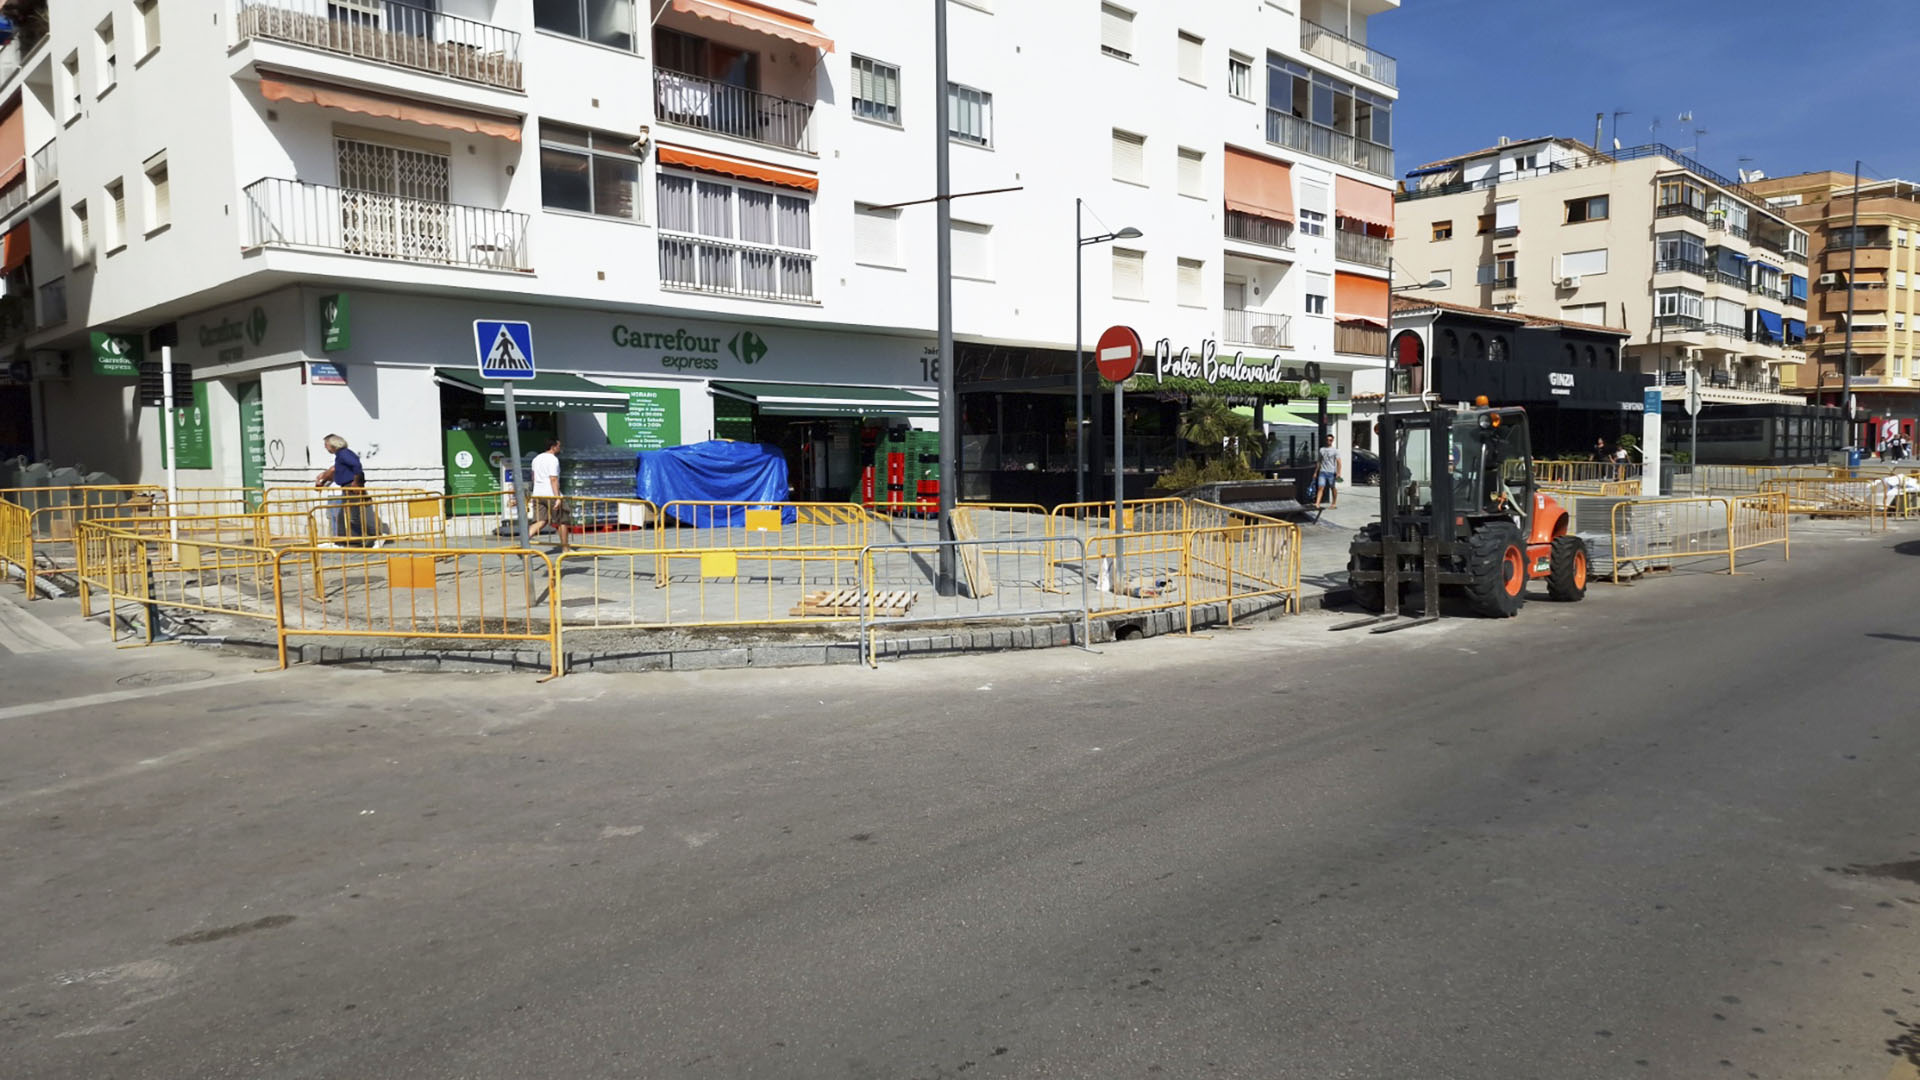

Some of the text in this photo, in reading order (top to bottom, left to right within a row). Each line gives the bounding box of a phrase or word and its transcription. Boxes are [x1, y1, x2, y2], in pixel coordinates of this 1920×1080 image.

[612, 325, 720, 354] Carrefour
[662, 354, 719, 371] express
[1155, 338, 1282, 384] Poke Boulevard
[1549, 372, 1574, 387] GINZA
